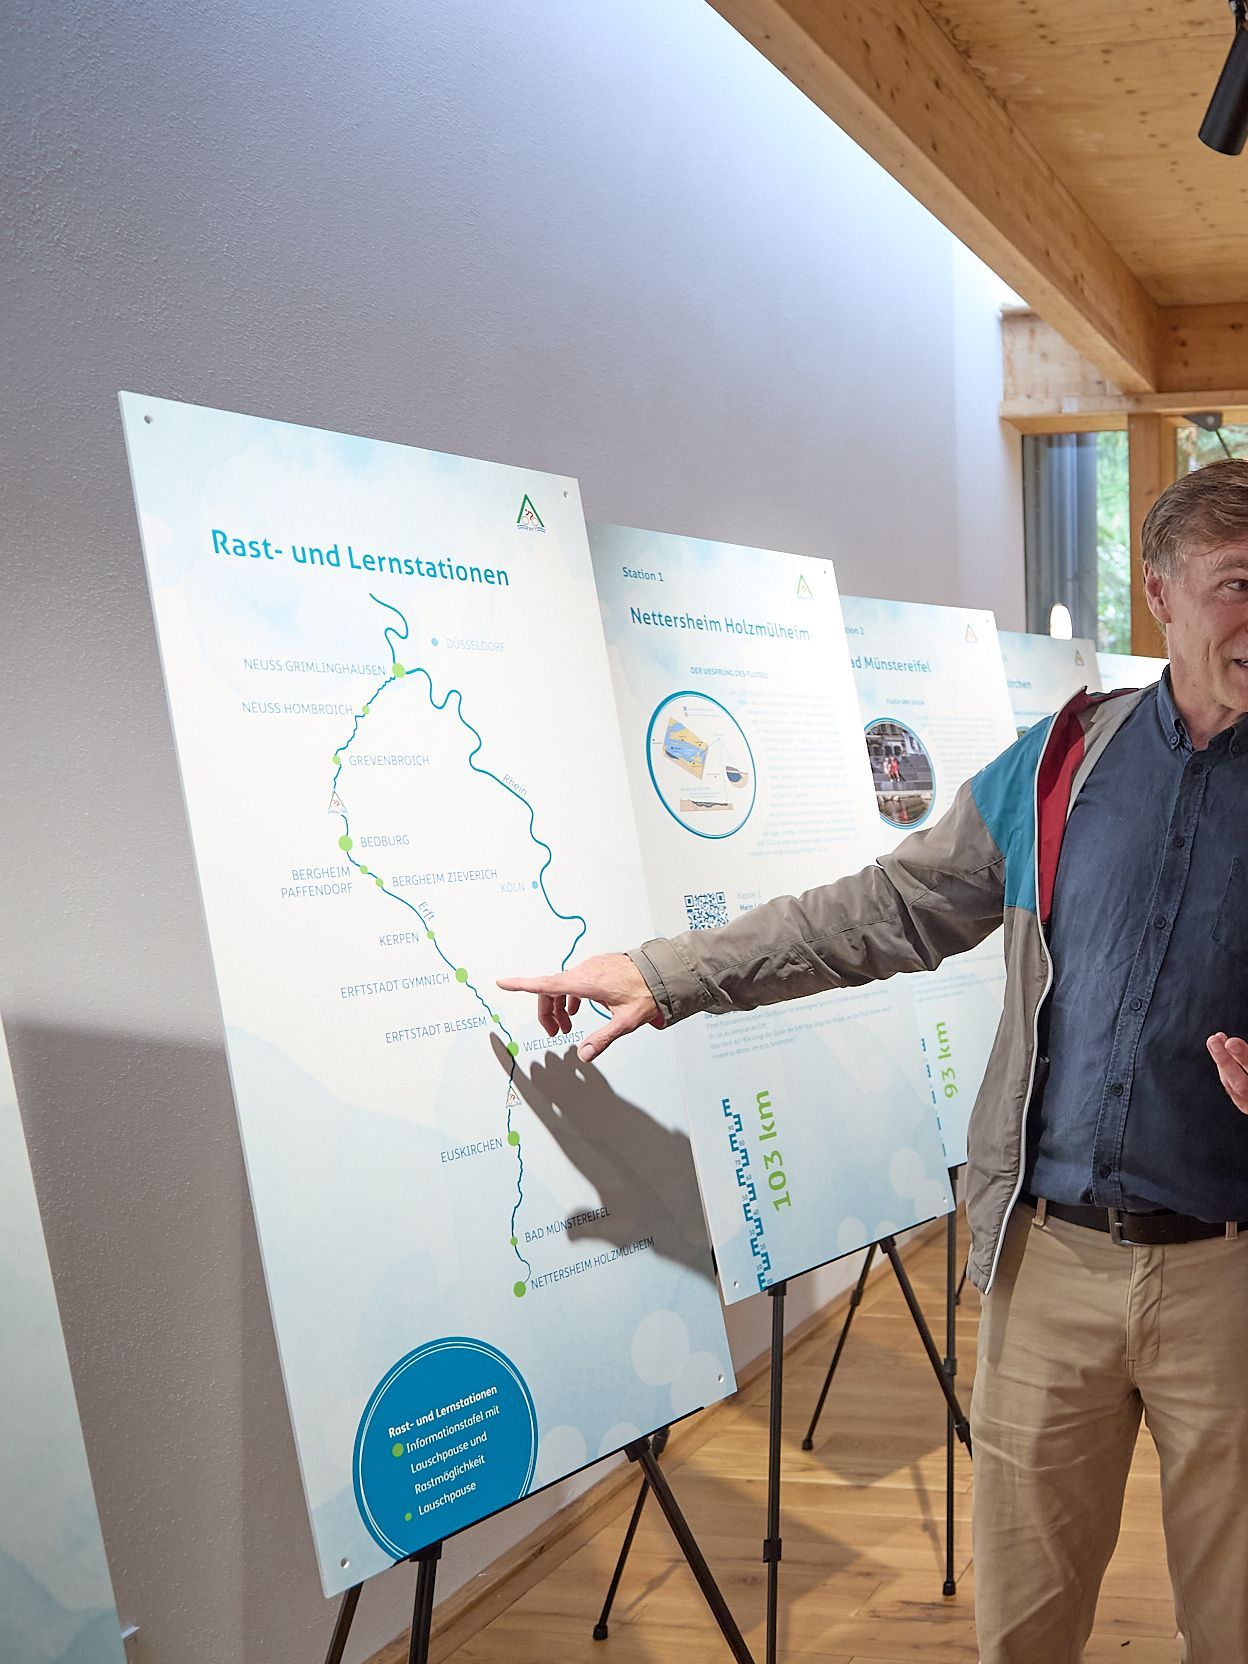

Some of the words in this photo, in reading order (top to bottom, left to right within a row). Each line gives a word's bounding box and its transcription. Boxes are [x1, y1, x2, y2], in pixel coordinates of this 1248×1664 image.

[211, 529, 283, 560] Rast-
[292, 544, 341, 568] und
[347, 546, 510, 586] Lernstationen
[622, 567, 656, 582] Station
[658, 572, 664, 582] 1
[630, 606, 722, 632] Nettersheim
[724, 617, 811, 641] Holzmülheim
[244, 658, 283, 672] NEUSS
[285, 660, 386, 676] GRIMLINGHAUSEN
[864, 656, 932, 673] Münstereifel
[242, 702, 283, 714] NEUSS
[284, 703, 353, 716] HOMBROICH
[349, 755, 430, 767] GREVENBROICH
[502, 773, 528, 796] Rhein
[360, 834, 410, 848] BEDBURG
[291, 866, 351, 881] BERGHEIM
[392, 873, 445, 888] BERGHEIM
[447, 869, 498, 884] ZIEVERICH
[281, 882, 353, 899] PAFFENDORF
[418, 901, 435, 922] Erft
[379, 932, 420, 947] KERPEN
[341, 979, 399, 999] ERFTSTADT
[402, 973, 450, 991] GYMNICH
[385, 1023, 441, 1044] ERFTSTADT
[444, 1016, 487, 1033] BLESSEM
[523, 1030, 586, 1053] WEILERSWIST
[936, 1022, 952, 1060] km
[941, 1067, 958, 1099] 93
[754, 1090, 778, 1141] km
[440, 1137, 504, 1163] EUSKIRCHEN
[763, 1150, 793, 1211] 103
[525, 1227, 545, 1243] BAD
[546, 1206, 611, 1237] MÜNSTEREIFEL
[531, 1259, 593, 1290] NETTERSHEIM
[594, 1236, 655, 1268] HOLZMÜLHEIM
[388, 1421, 414, 1438] Rast-
[416, 1410, 435, 1427] und
[435, 1385, 498, 1418] Lernstationen
[406, 1411, 484, 1453] Informationstafel
[485, 1405, 500, 1420] mit
[410, 1442, 469, 1474] Lauschpause
[470, 1431, 488, 1447] und
[414, 1455, 486, 1494] Rastmöglichkeit
[418, 1482, 477, 1516] Lauschpause
